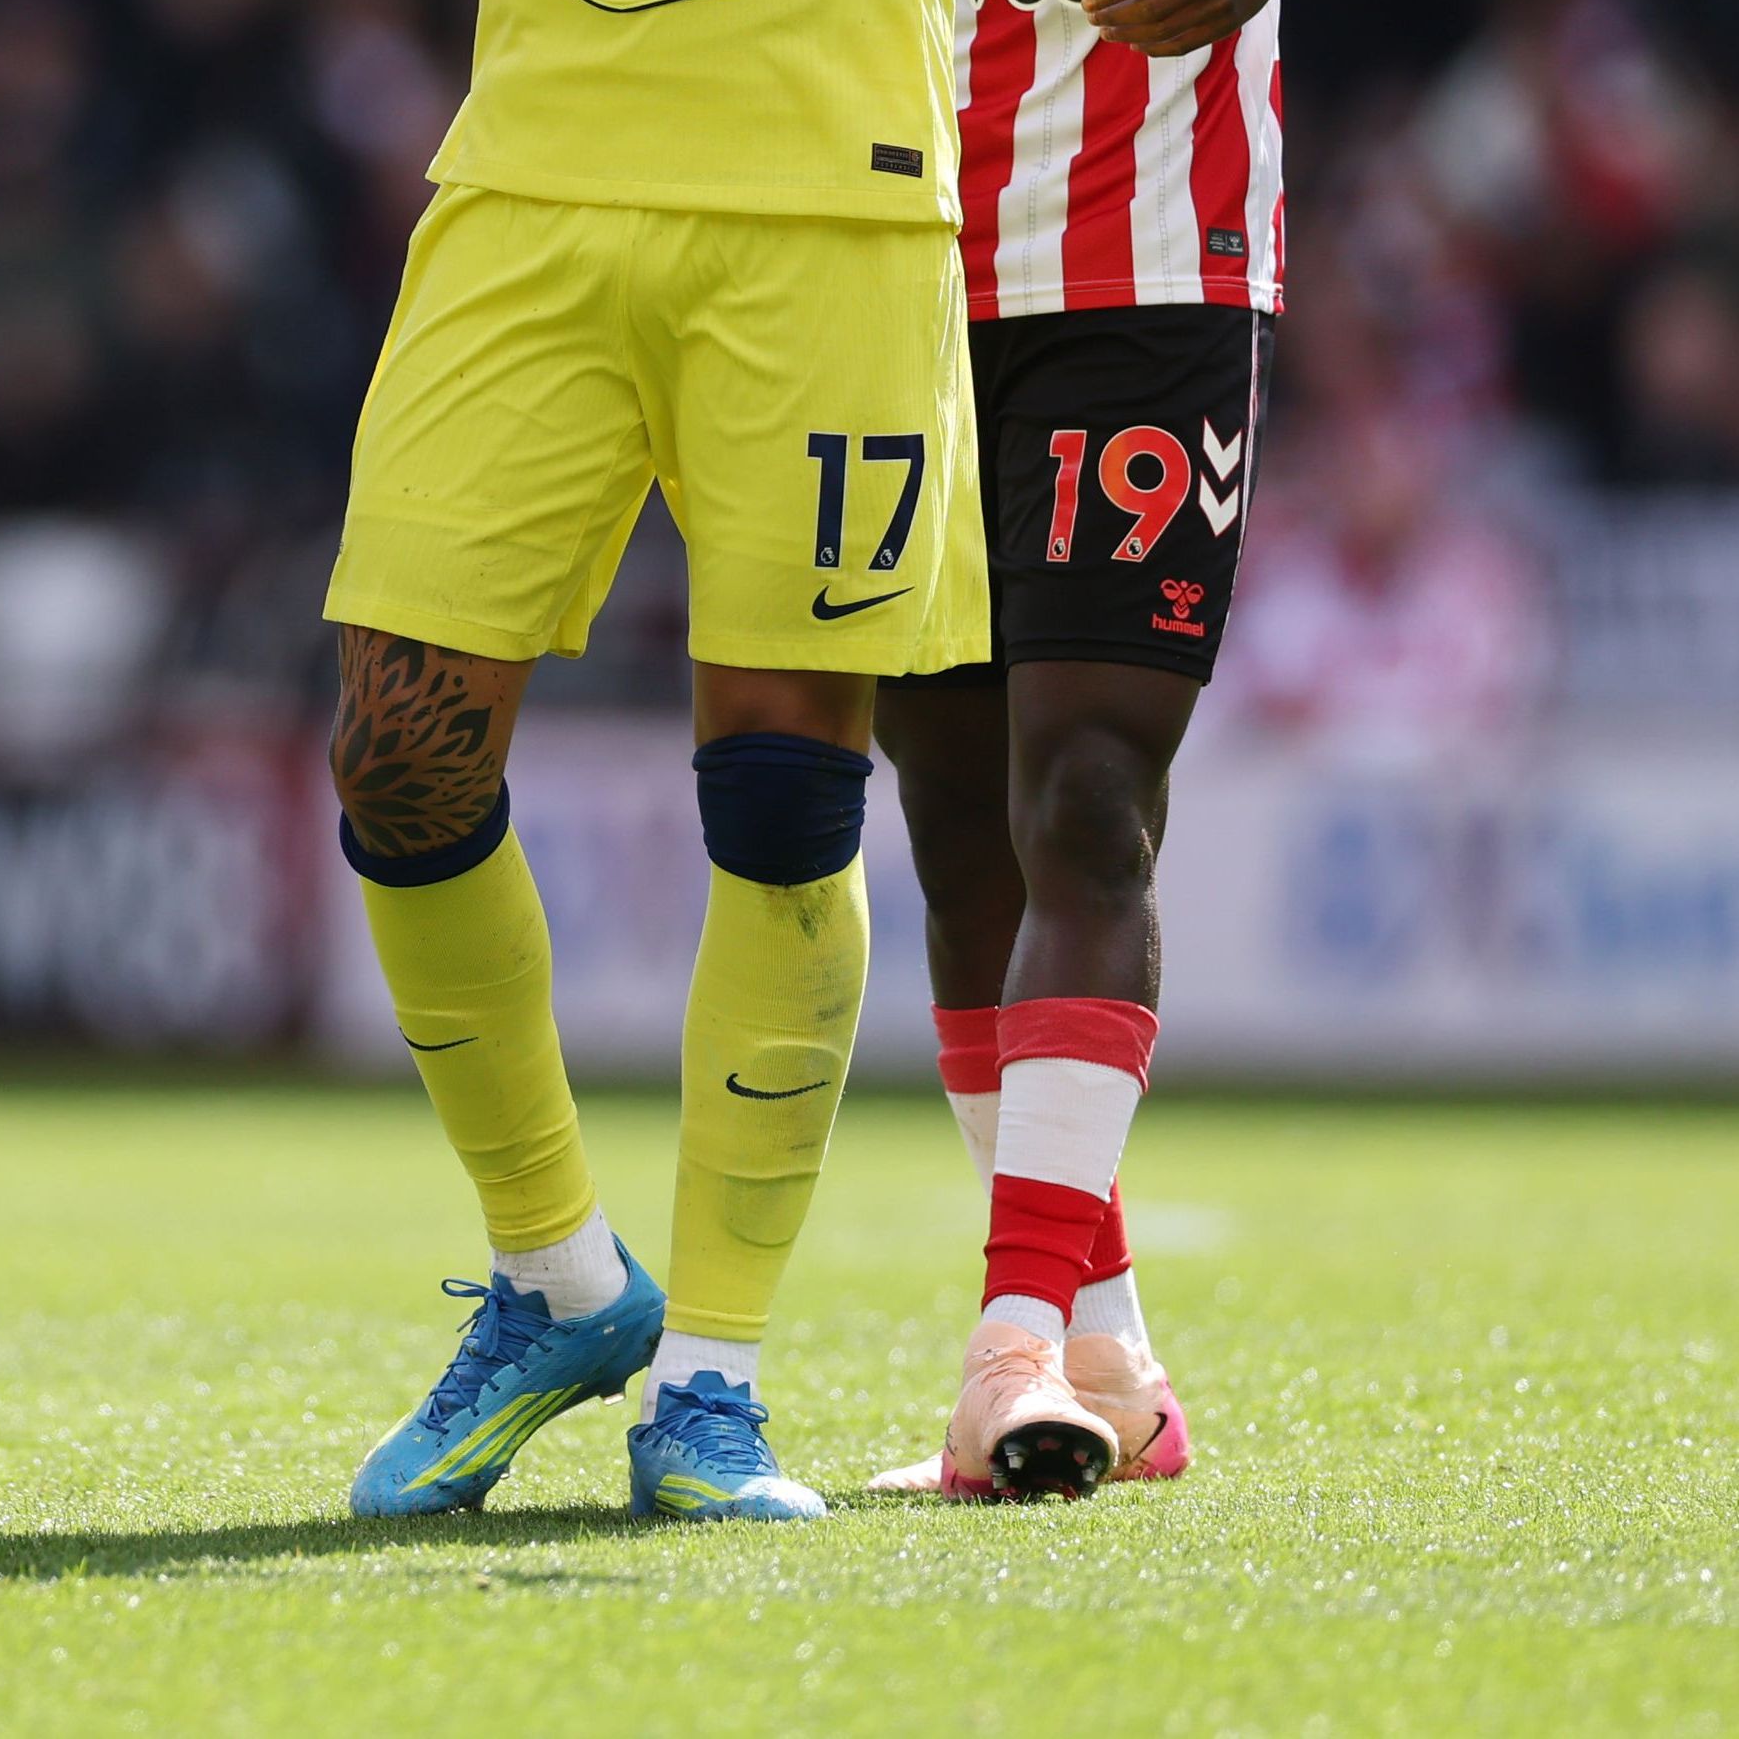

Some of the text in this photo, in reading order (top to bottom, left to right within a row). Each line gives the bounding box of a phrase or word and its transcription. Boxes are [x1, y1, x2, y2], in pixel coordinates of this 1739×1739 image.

[807, 432, 926, 572] 17
[1046, 424, 1192, 563] 19
[1152, 613, 1204, 637] hummel
